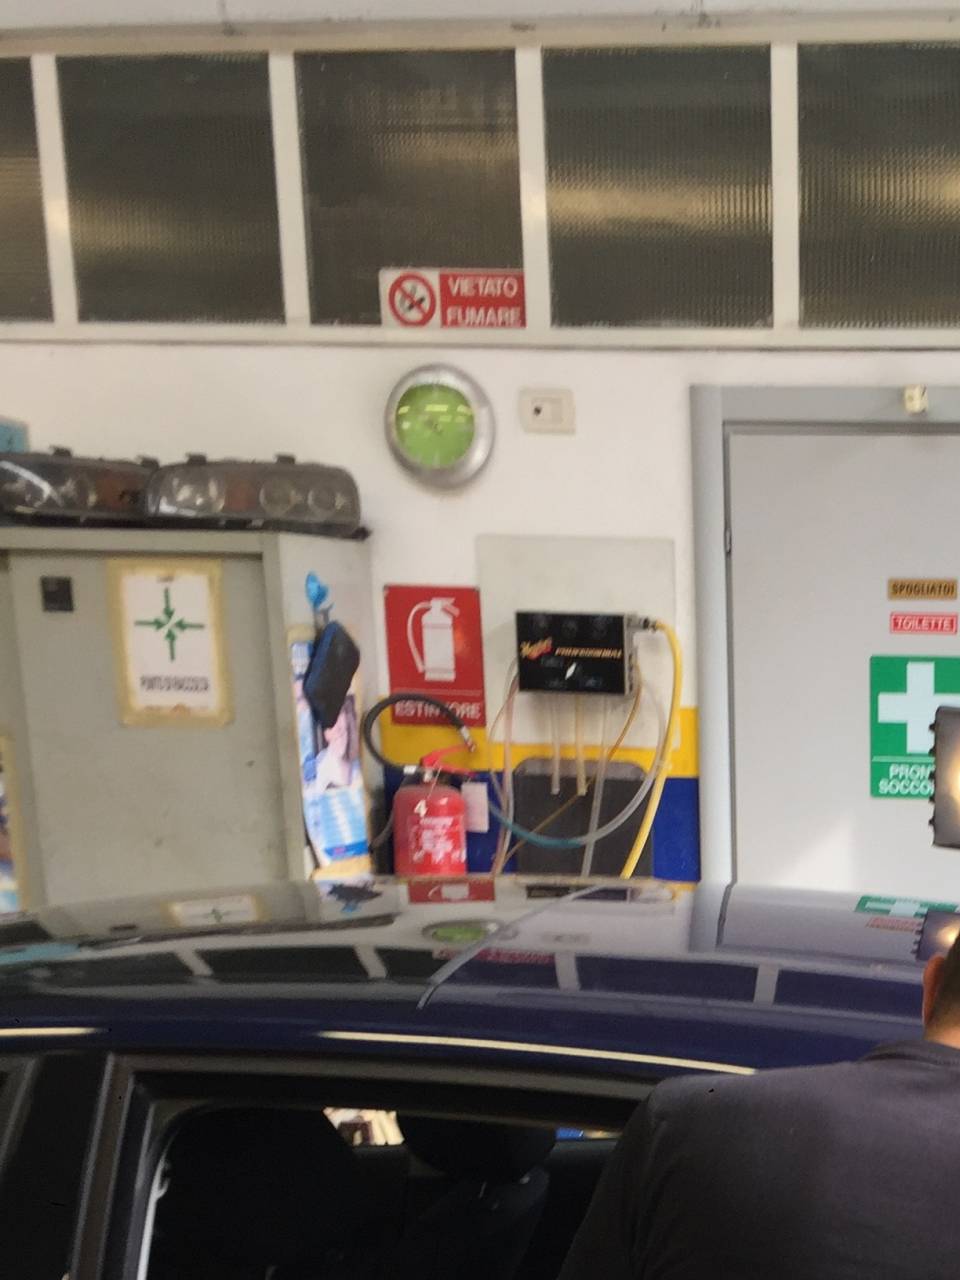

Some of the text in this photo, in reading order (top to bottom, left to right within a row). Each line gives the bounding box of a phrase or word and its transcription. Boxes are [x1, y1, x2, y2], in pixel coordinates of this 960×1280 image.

[448, 276, 519, 298] VIETATO
[446, 305, 521, 326] FUMARE
[893, 615, 951, 631] TOILETTE
[394, 699, 481, 719] ESTINORE
